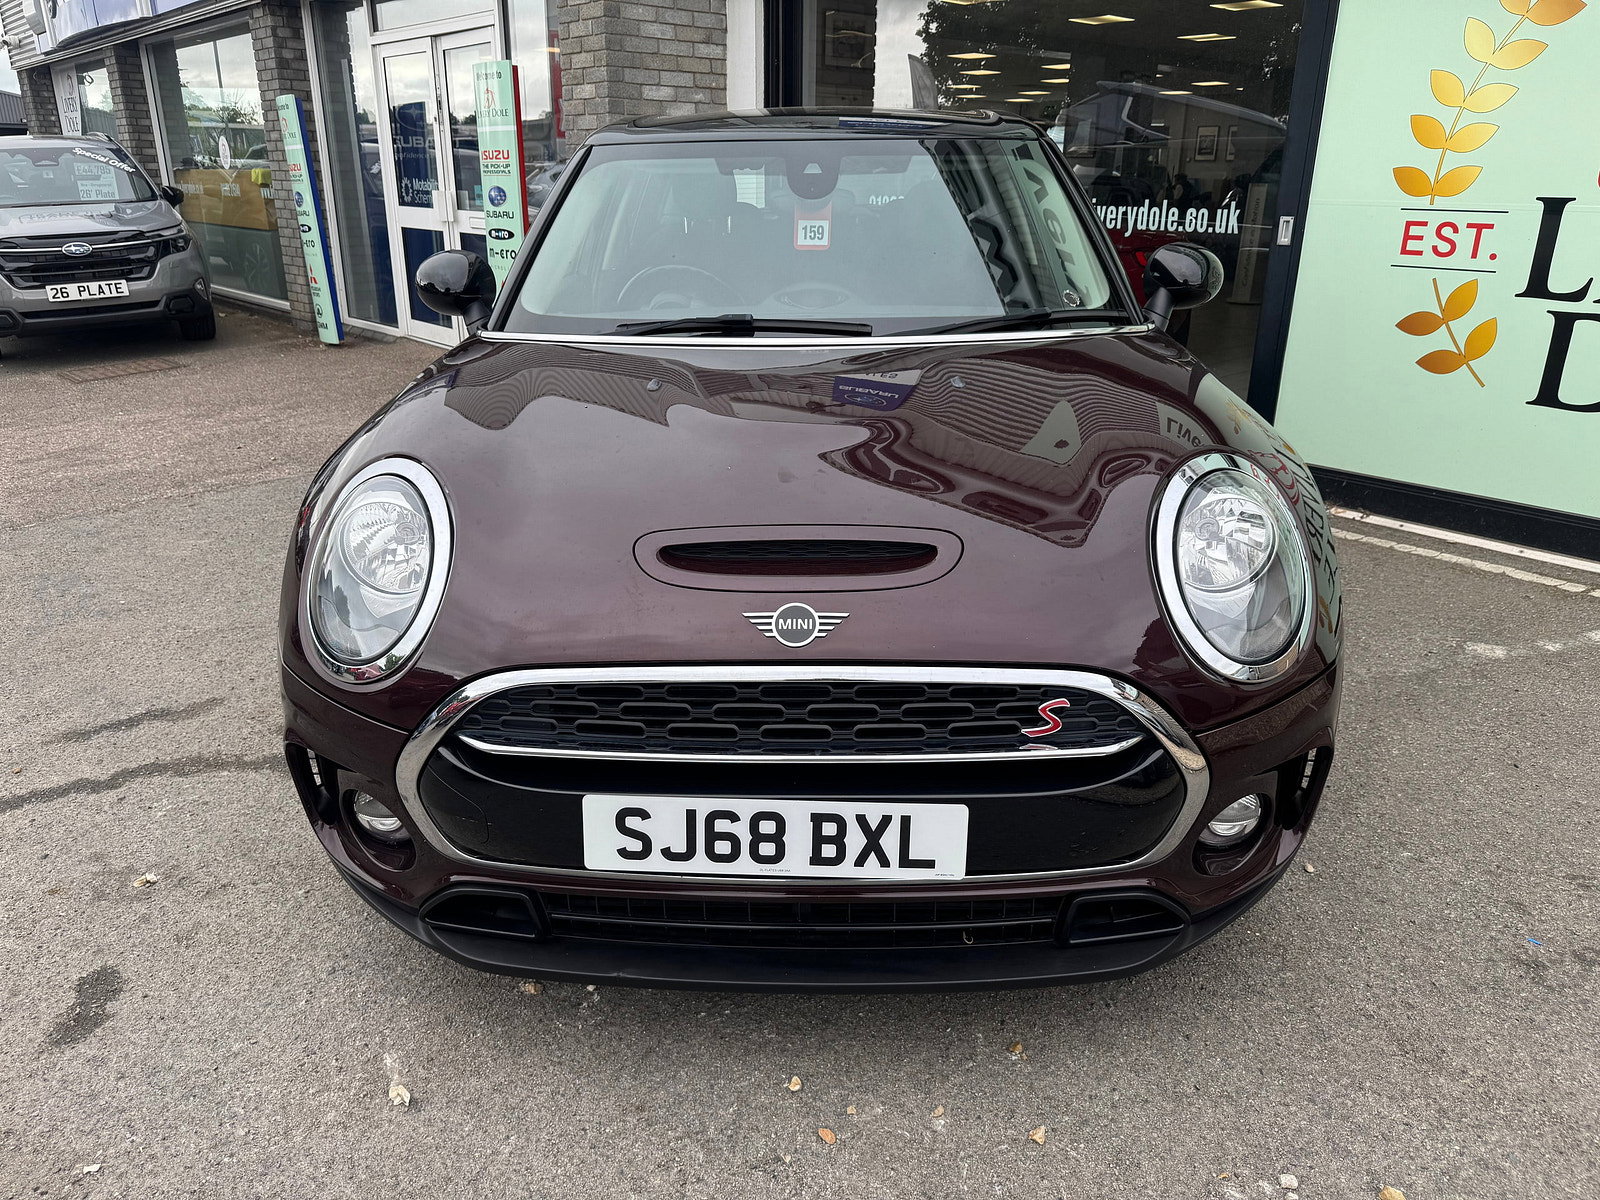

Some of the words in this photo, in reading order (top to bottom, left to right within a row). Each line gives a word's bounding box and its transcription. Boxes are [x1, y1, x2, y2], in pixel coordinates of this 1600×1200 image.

[492, 108, 509, 118] DOLE
[73, 147, 109, 162] Special
[109, 160, 136, 172] Offer
[481, 150, 510, 160] ISUZU
[95, 189, 116, 198] Plate
[486, 210, 514, 219] SUBARU
[801, 224, 824, 240] 159
[1400, 220, 1498, 261] EST.
[50, 287, 70, 299] 26
[77, 282, 125, 297] PLATE
[778, 618, 813, 630] MINI
[1020, 698, 1071, 738] S
[614, 806, 787, 866] SJ68
[809, 812, 937, 870] BXL
